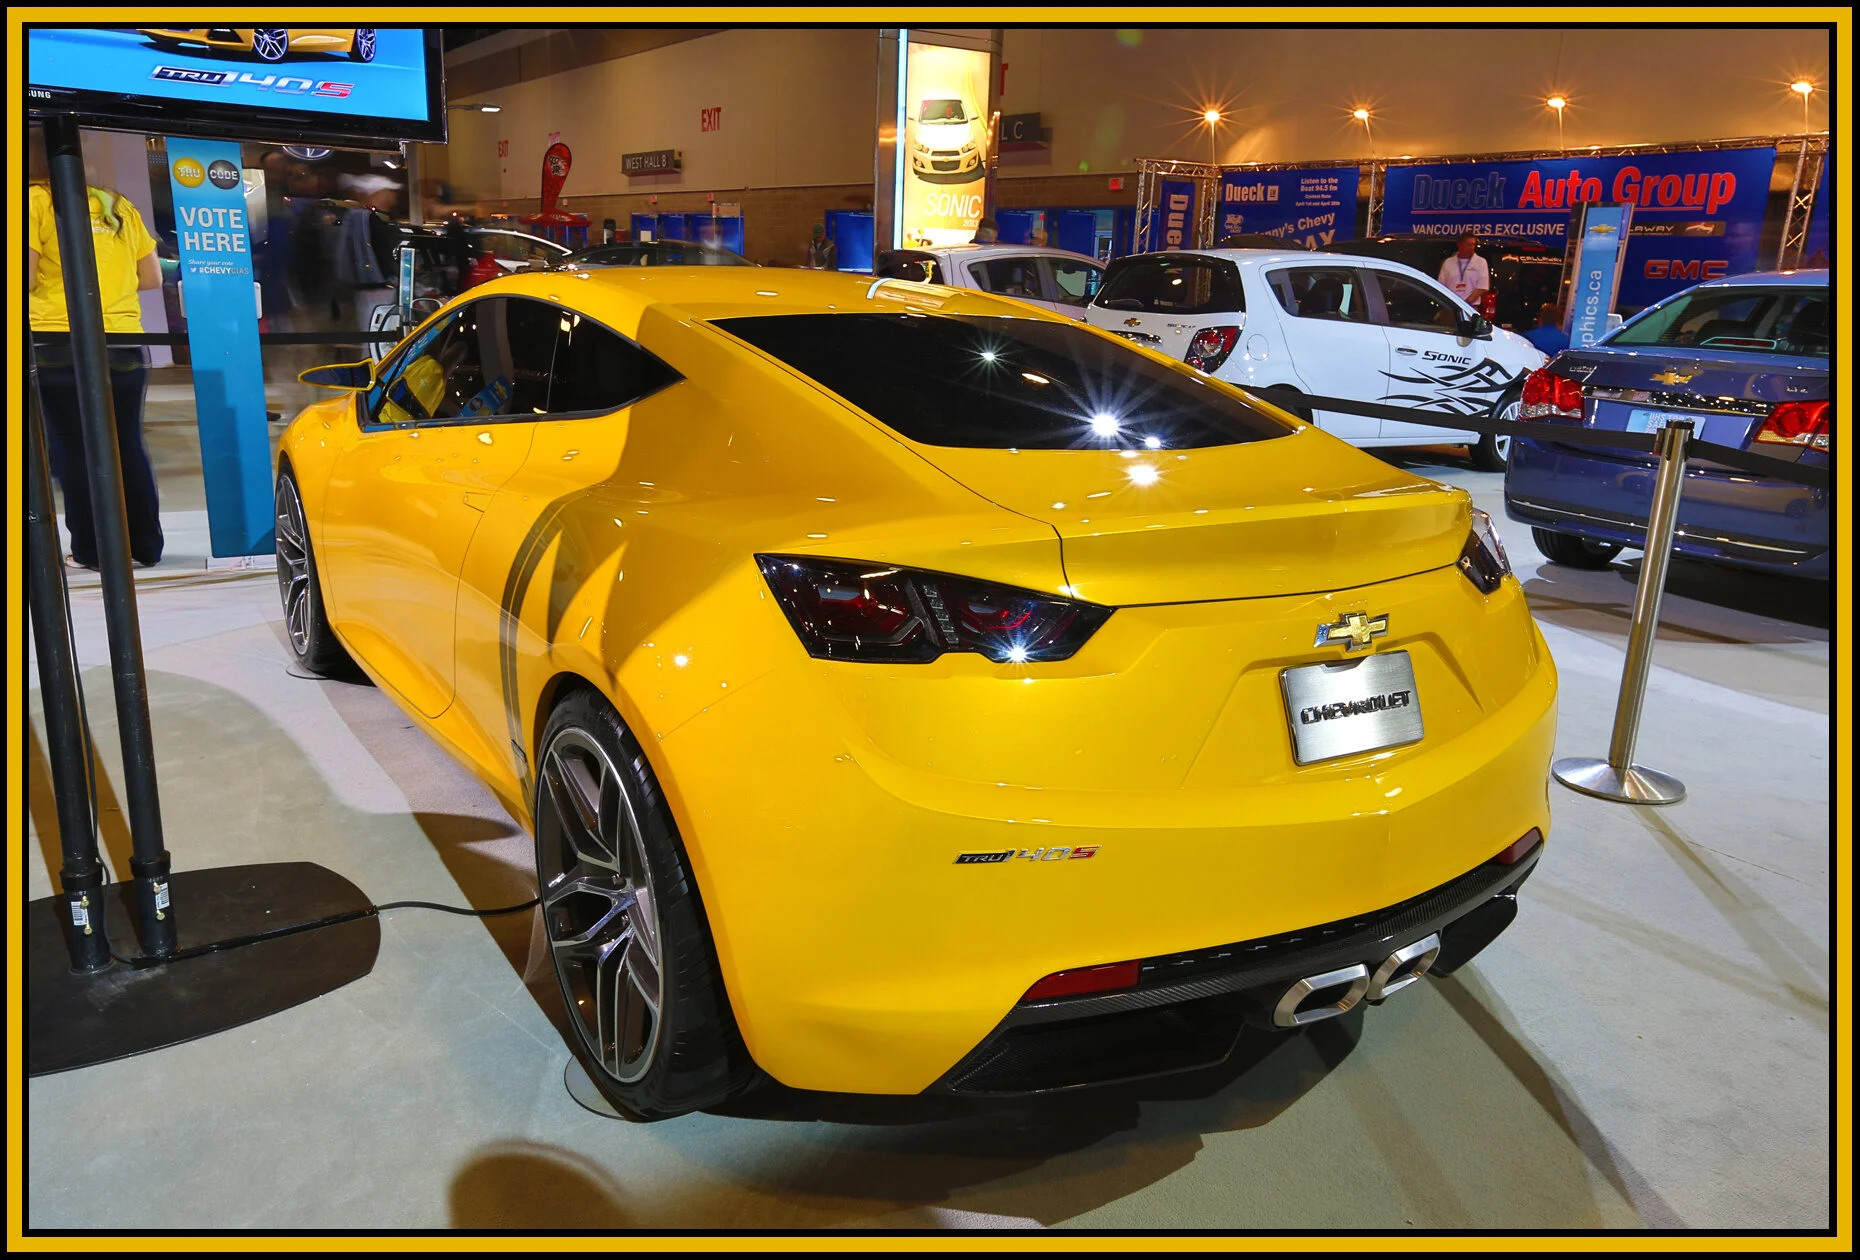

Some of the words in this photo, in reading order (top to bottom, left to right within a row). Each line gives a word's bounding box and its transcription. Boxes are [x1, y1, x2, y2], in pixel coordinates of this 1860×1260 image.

[701, 107, 722, 132] EXIT
[625, 156, 643, 170] WEST
[644, 155, 661, 168] HALL
[178, 167, 201, 178] TRU
[209, 169, 239, 180] CODE
[1301, 177, 1319, 185] Listen
[1225, 182, 1265, 202] Dueck
[1412, 171, 1506, 210] Dueck
[1518, 170, 1603, 208] Auto
[1612, 166, 1736, 214] Group
[924, 193, 982, 218] SONIC
[180, 206, 244, 229] VOTE
[1297, 212, 1336, 231] Chevy
[1412, 223, 1493, 236] VANCOUVER'S
[1495, 223, 1565, 236] EXCLUSIVE
[183, 231, 246, 253] HERE
[1644, 259, 1729, 281] GMC
[1422, 350, 1472, 365] SONIC
[1300, 690, 1411, 725] CHEVROLET
